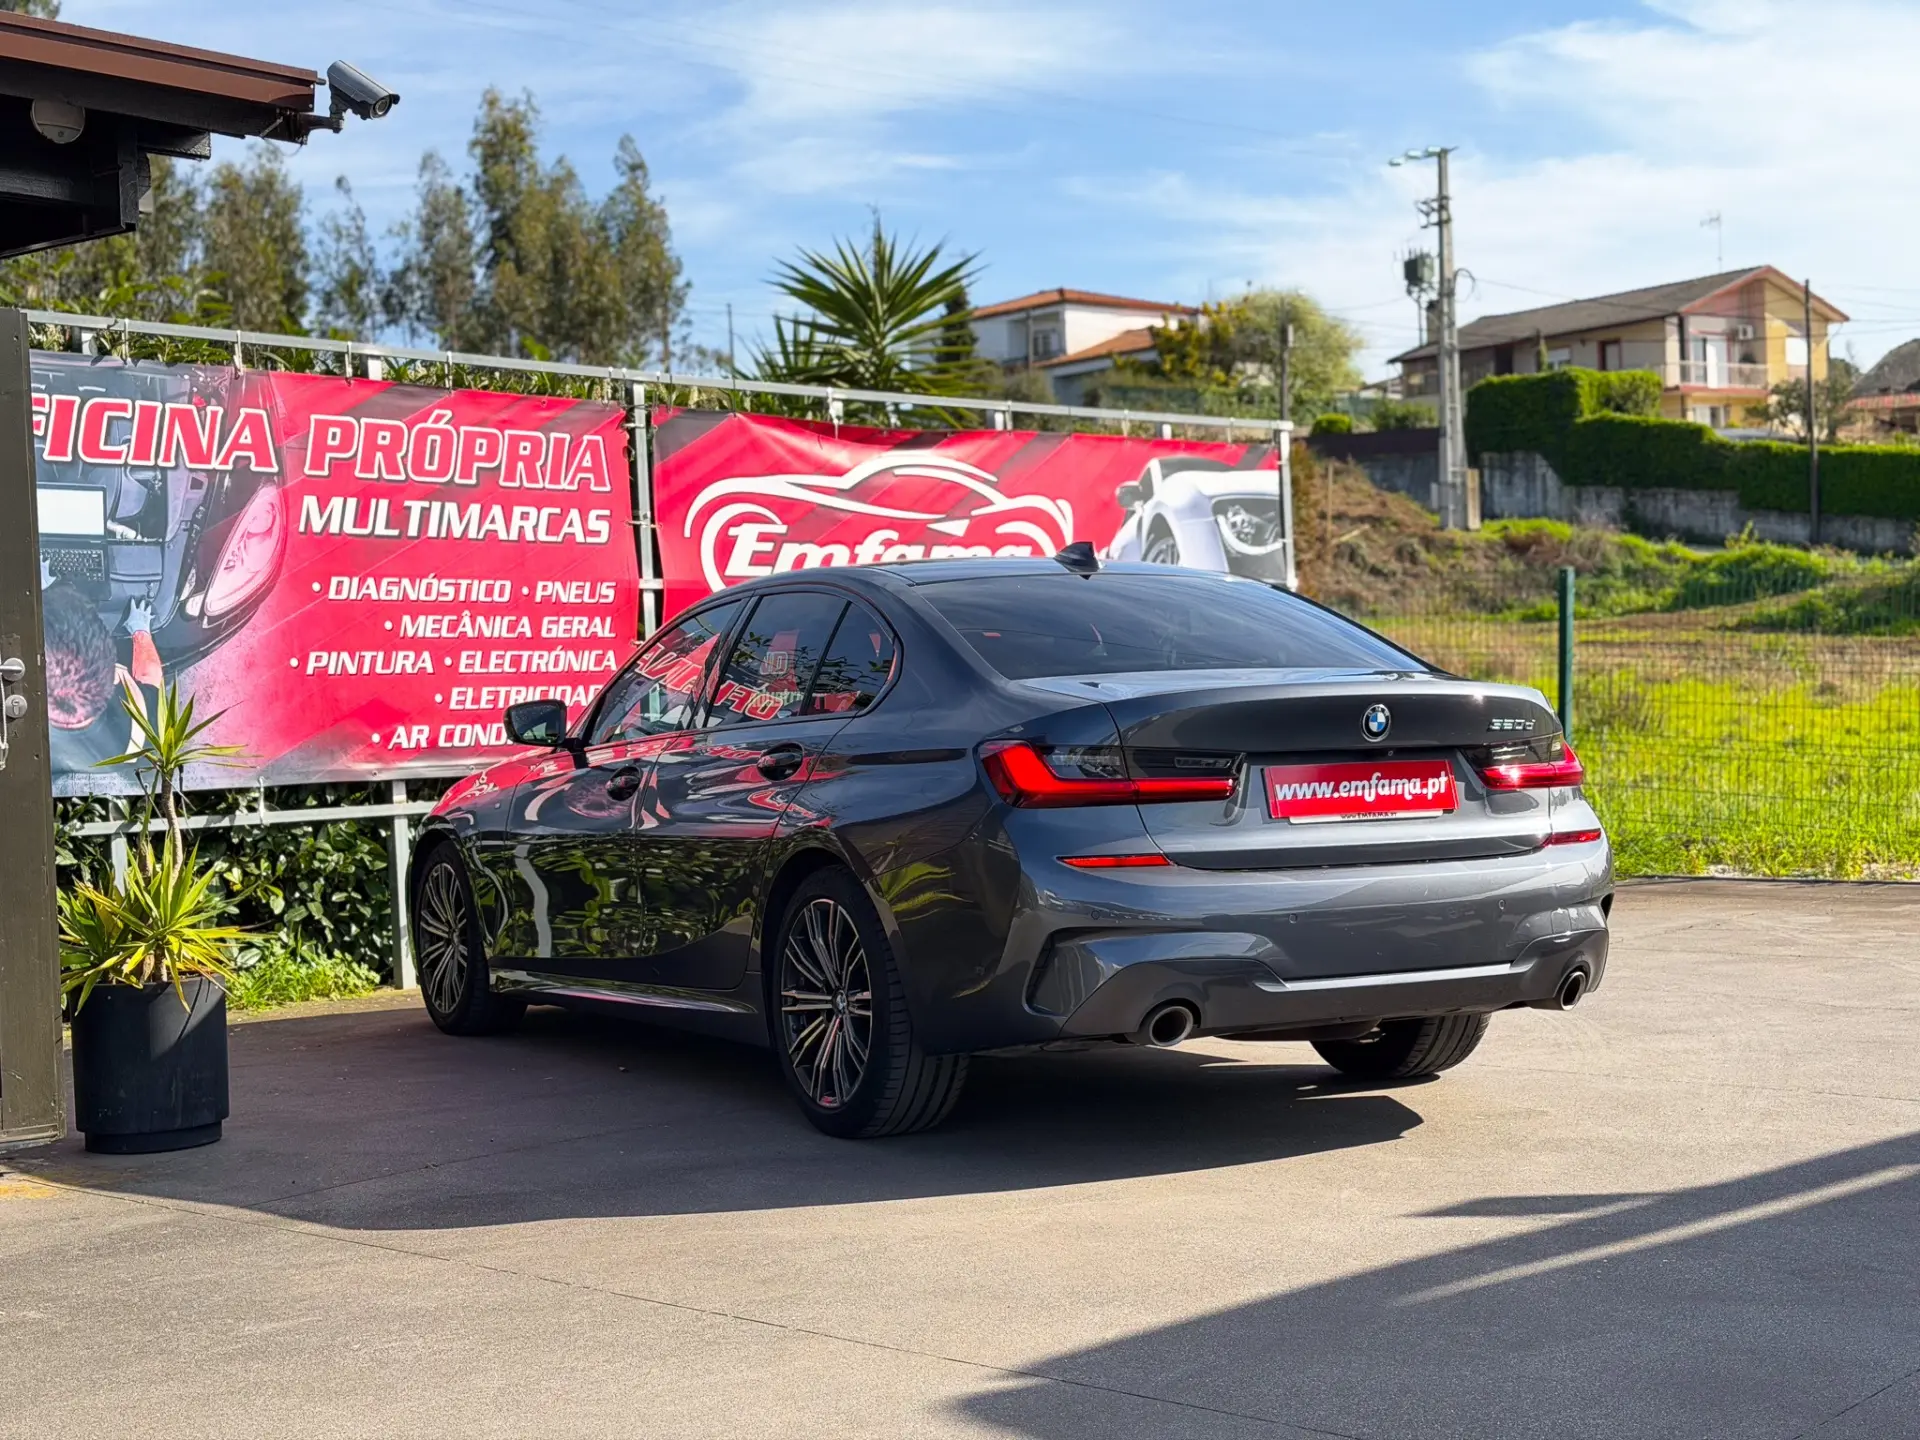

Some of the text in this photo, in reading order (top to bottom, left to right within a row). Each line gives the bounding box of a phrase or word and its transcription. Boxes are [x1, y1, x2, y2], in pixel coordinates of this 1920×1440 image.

[303, 409, 611, 491] PRÓPRIA
[299, 494, 611, 543] MULTIMARCAS
[328, 573, 616, 603] DIAGNÓSTICO PNEUS
[399, 610, 616, 639] MECÂNICA GERAL
[305, 645, 617, 675] PINTURA ELECTRÓNICA
[387, 724, 430, 750] AR
[1275, 770, 1448, 802] www.emfama.pt
